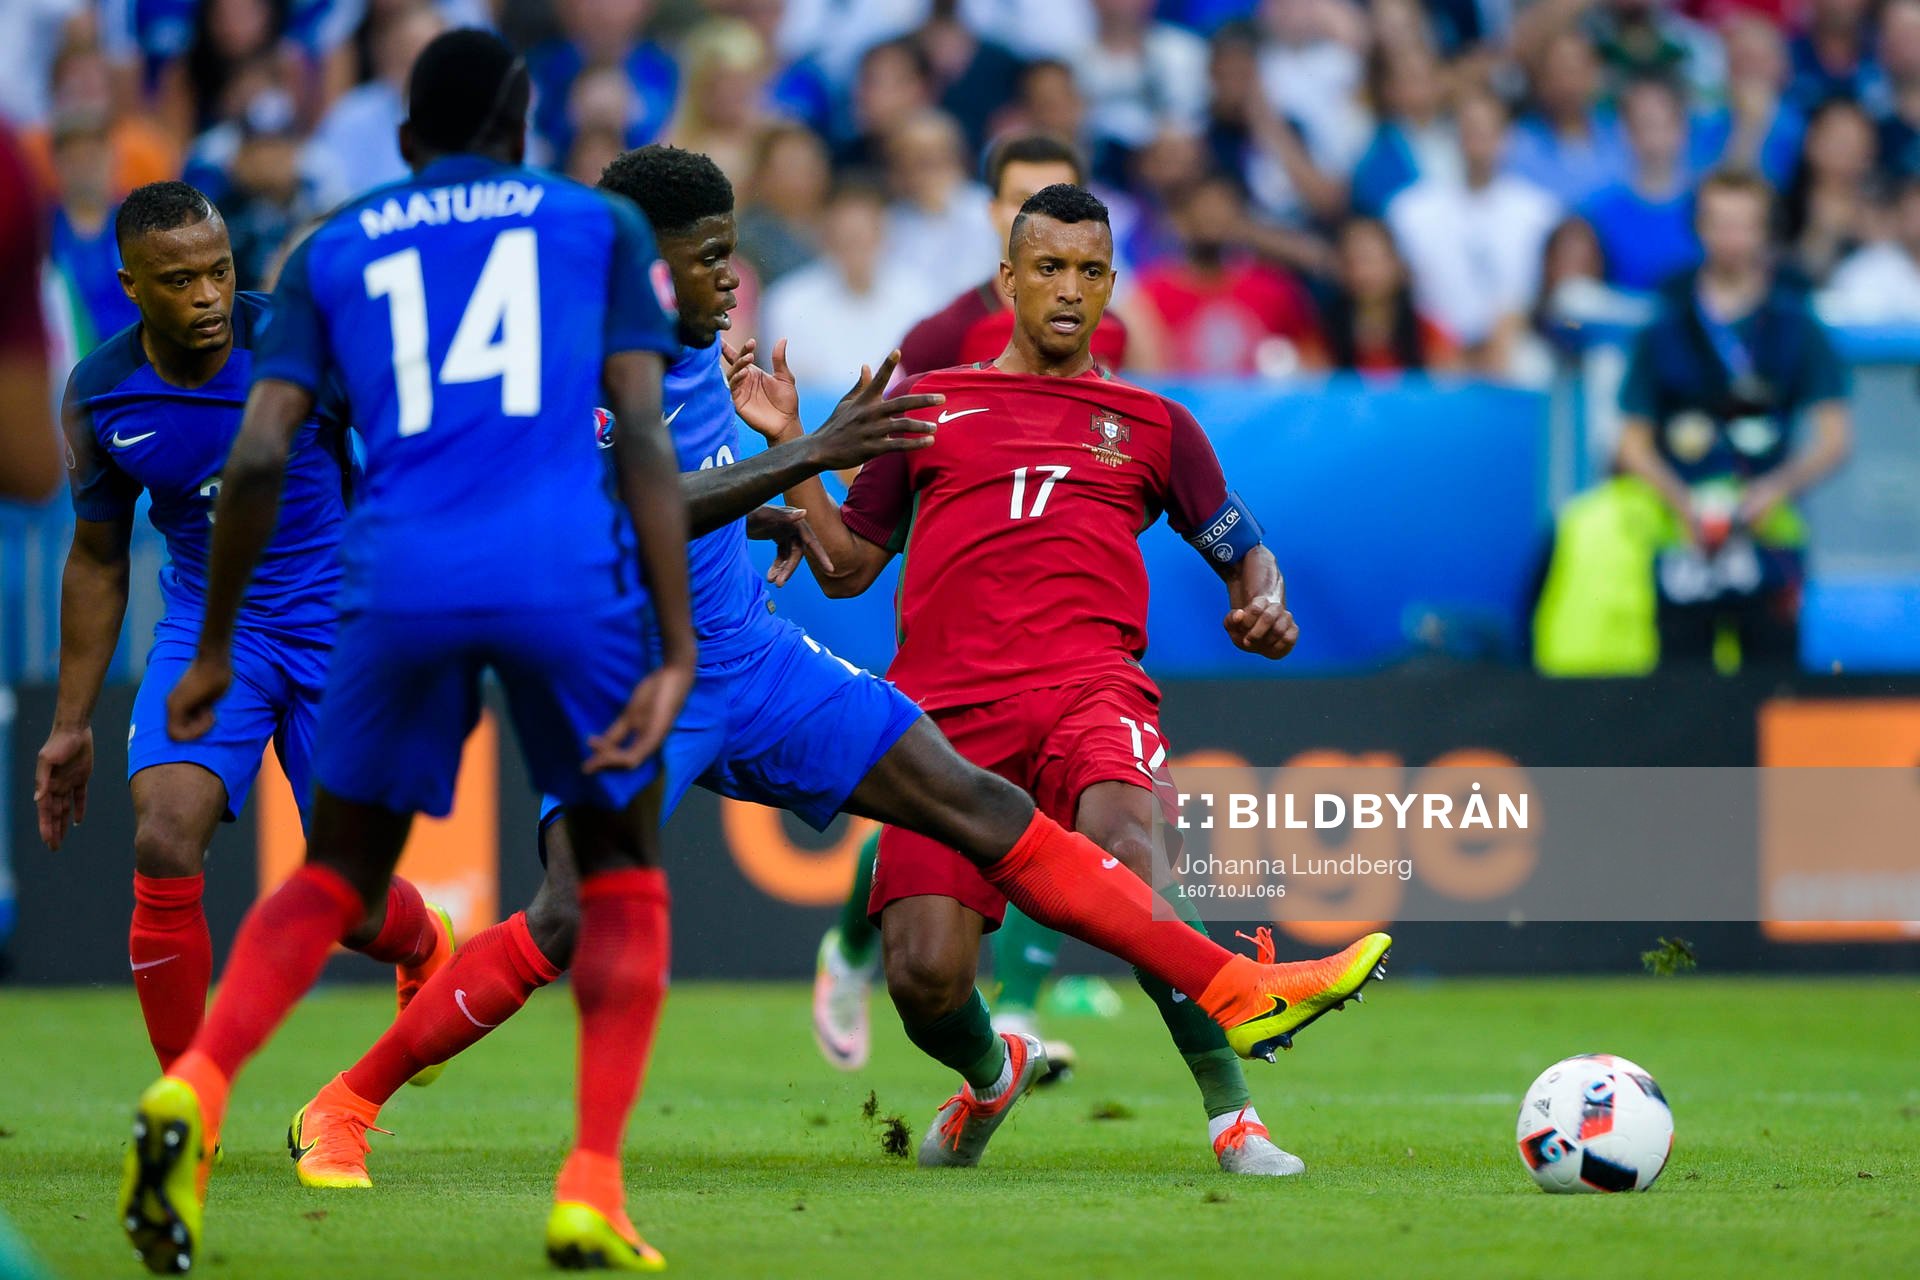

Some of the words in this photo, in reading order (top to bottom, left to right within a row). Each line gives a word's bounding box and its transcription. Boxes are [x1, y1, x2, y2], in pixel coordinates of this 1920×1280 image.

[359, 180, 544, 240] MATUIDI
[362, 226, 542, 438] 14
[1009, 464, 1072, 520] 17
[1225, 508, 1240, 525] NO
[1212, 522, 1228, 537] TO
[1119, 715, 1166, 774] 17
